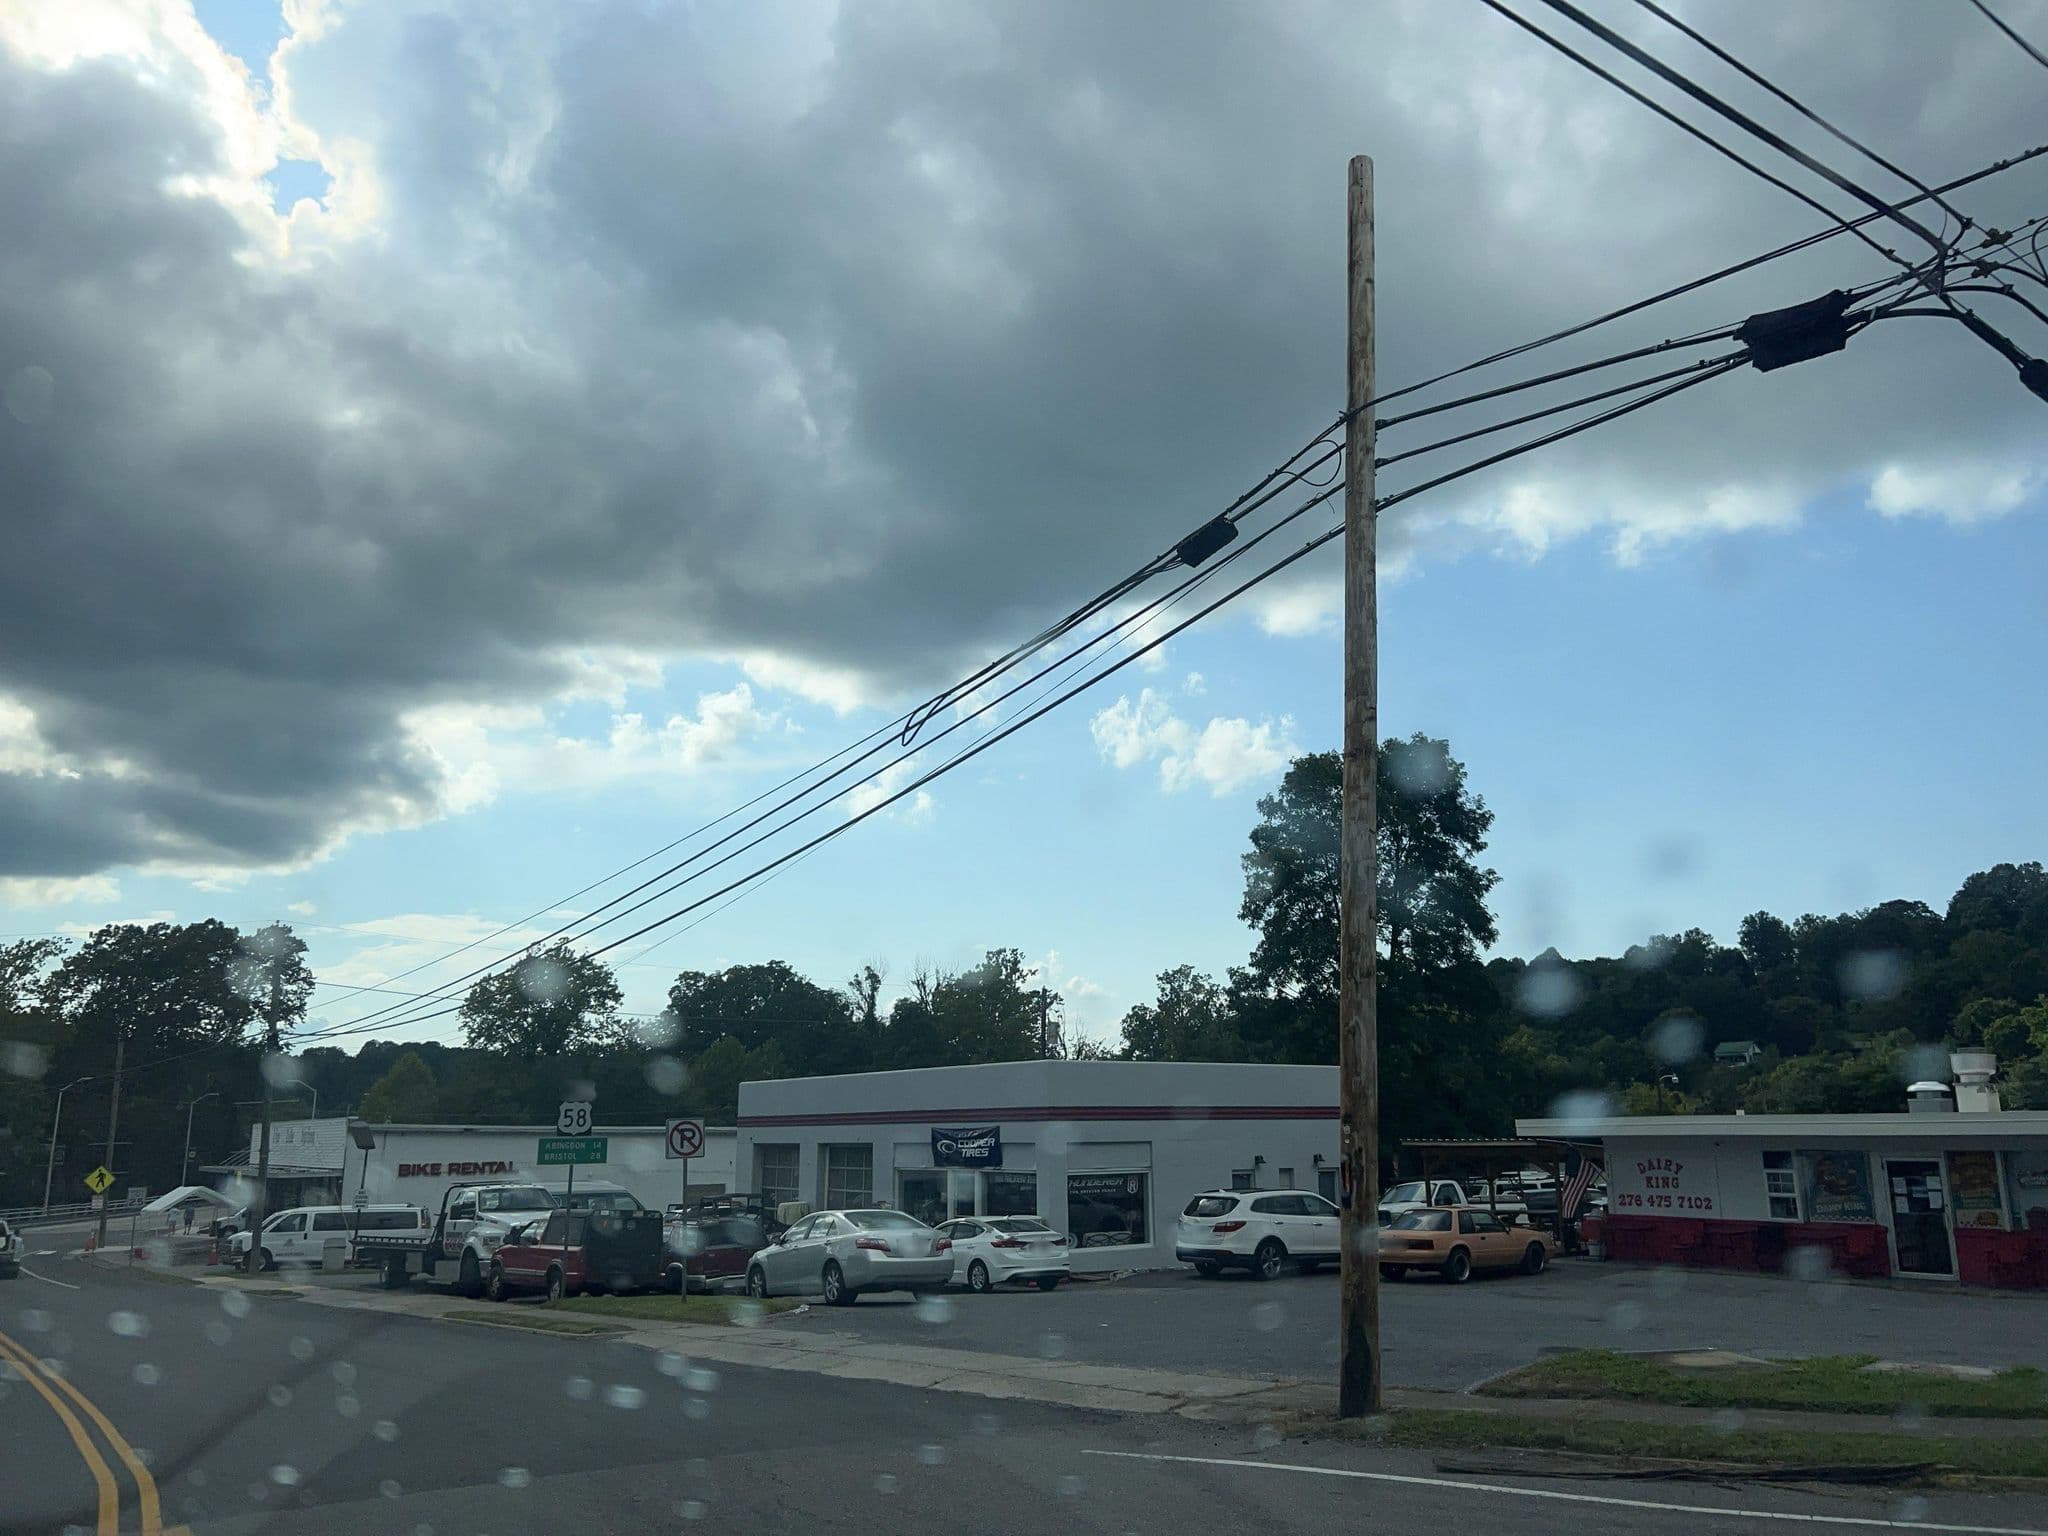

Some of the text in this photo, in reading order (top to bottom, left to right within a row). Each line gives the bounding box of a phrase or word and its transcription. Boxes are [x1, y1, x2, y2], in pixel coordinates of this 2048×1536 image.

[563, 1108, 587, 1127] 58
[544, 1152, 577, 1161] BRISTOL
[961, 1147, 990, 1158] TIRES
[398, 1161, 516, 1177] BIKE RENTAL
[1636, 1158, 1684, 1175] DAIRY
[1645, 1176, 1680, 1189] KING
[129, 1197, 144, 1207] 25
[1618, 1194, 1713, 1210] 276 475 7102
